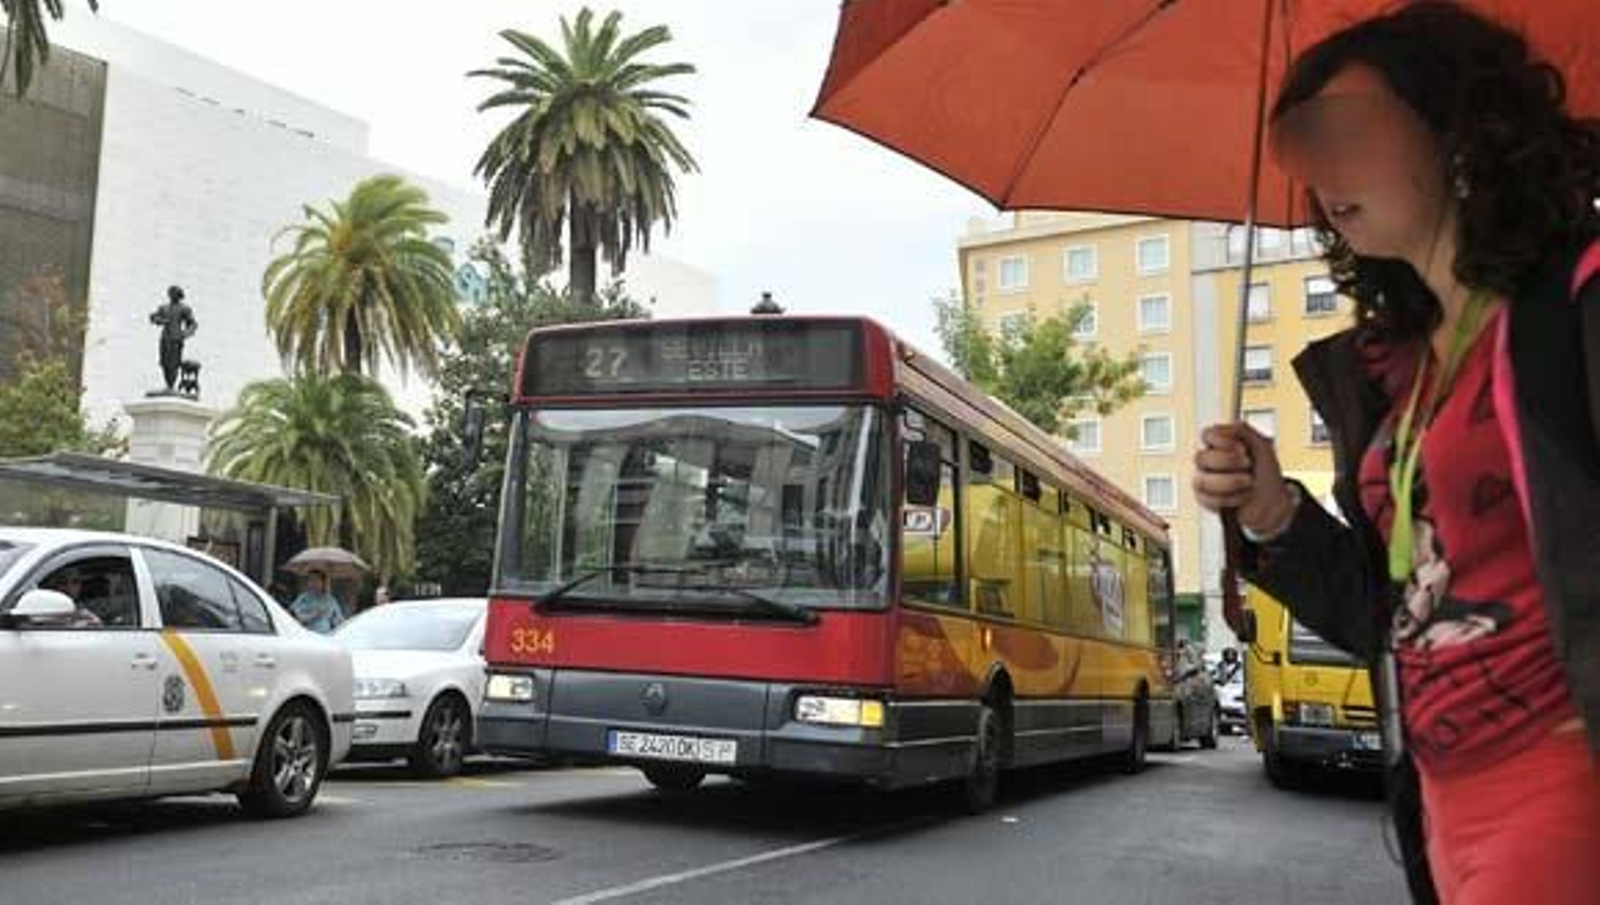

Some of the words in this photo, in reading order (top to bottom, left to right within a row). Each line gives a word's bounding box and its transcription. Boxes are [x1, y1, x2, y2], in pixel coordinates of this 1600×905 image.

[584, 348, 627, 378] 27
[688, 359, 749, 381] ESTE
[510, 627, 555, 655] 334
